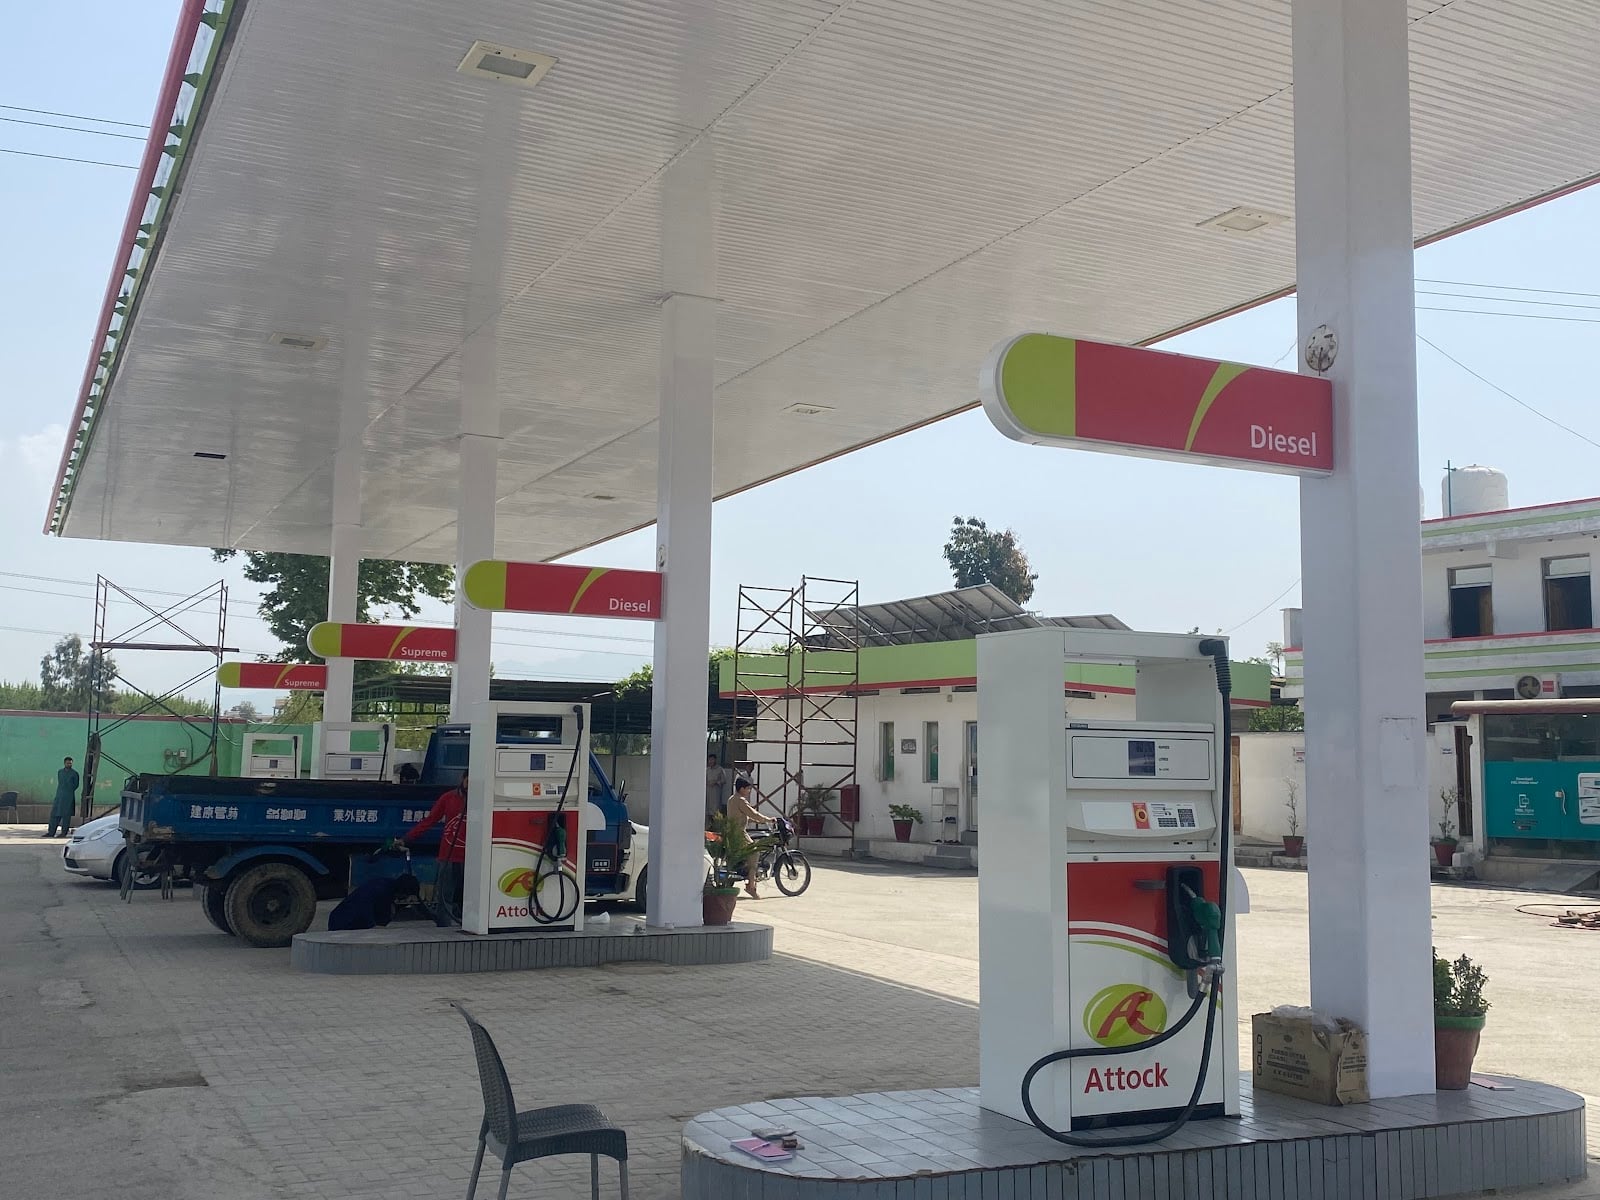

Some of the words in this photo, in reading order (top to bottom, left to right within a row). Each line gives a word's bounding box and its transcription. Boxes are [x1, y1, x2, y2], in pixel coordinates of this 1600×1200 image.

[1250, 424, 1317, 457] Diesel
[608, 597, 651, 613] Diesel
[401, 646, 448, 658] Supreme
[284, 678, 320, 688] Supreme
[496, 905, 544, 918] Atto
[1084, 1062, 1169, 1094] Attock
